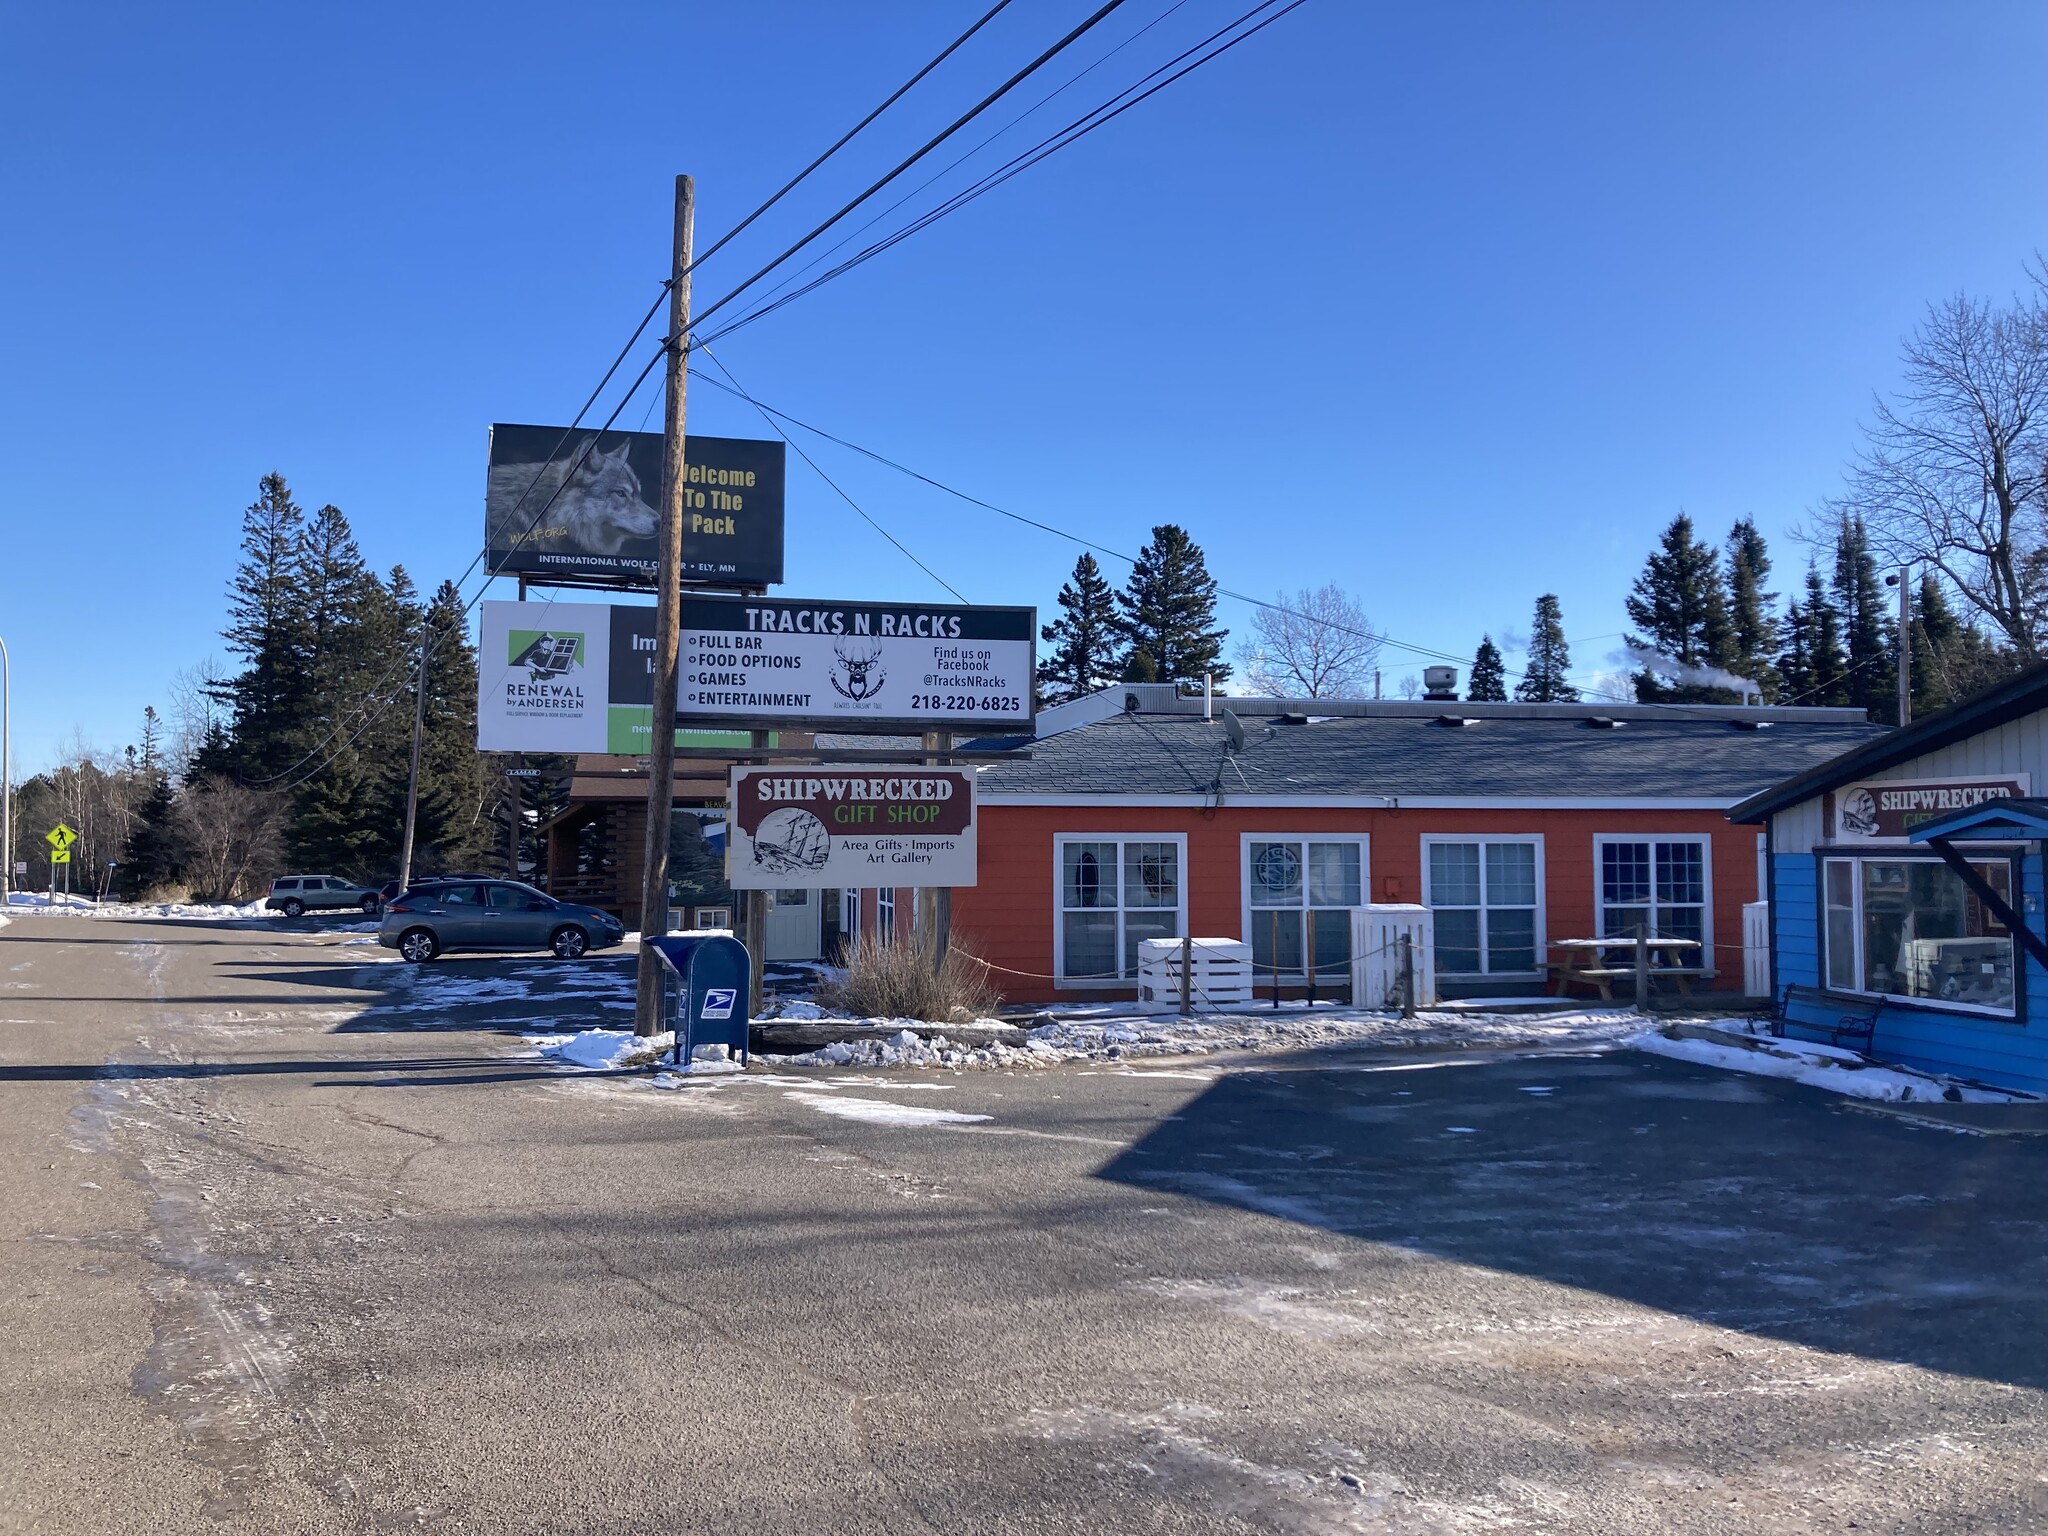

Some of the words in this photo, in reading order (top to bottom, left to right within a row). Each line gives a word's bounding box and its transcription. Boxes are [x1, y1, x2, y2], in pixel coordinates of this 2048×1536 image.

[684, 488, 706, 509] To
[711, 490, 743, 511] The
[692, 513, 735, 535] Pack
[510, 526, 568, 544] WOLF.ORG
[539, 554, 618, 567] INTERNATIONAL
[620, 559, 649, 569] WOLF
[698, 562, 716, 573] ELY,
[719, 564, 736, 573] MN
[745, 608, 845, 634] TRACKS
[854, 613, 870, 635] N
[881, 613, 961, 638] RACKS
[699, 635, 731, 649] FULL
[735, 636, 762, 650] BAR
[699, 653, 737, 667] FOOD
[741, 654, 801, 669] OPTIONS
[934, 646, 958, 659] Find
[961, 650, 974, 659] us
[977, 650, 991, 660] on
[937, 658, 989, 671] Facebook
[698, 672, 746, 686] GAMES
[923, 674, 1006, 688] @TracksNRacks
[505, 683, 584, 698] RENEWAL
[506, 698, 517, 707] by
[518, 699, 584, 709] ANDERSEN
[698, 691, 811, 707] ENTERTAINMENT
[911, 694, 1020, 711] 218-220-6825
[757, 778, 953, 801] SHIPWRECKED
[704, 800, 727, 808] BEAVE
[1881, 786, 2012, 811] SHIPWRECKED
[834, 804, 878, 823] GIFT
[887, 804, 940, 823] SHOP
[841, 840, 868, 850] Area
[875, 839, 902, 850] Gifts
[912, 840, 955, 852] Imports
[866, 853, 885, 863] Art
[891, 852, 933, 865] Gallery
